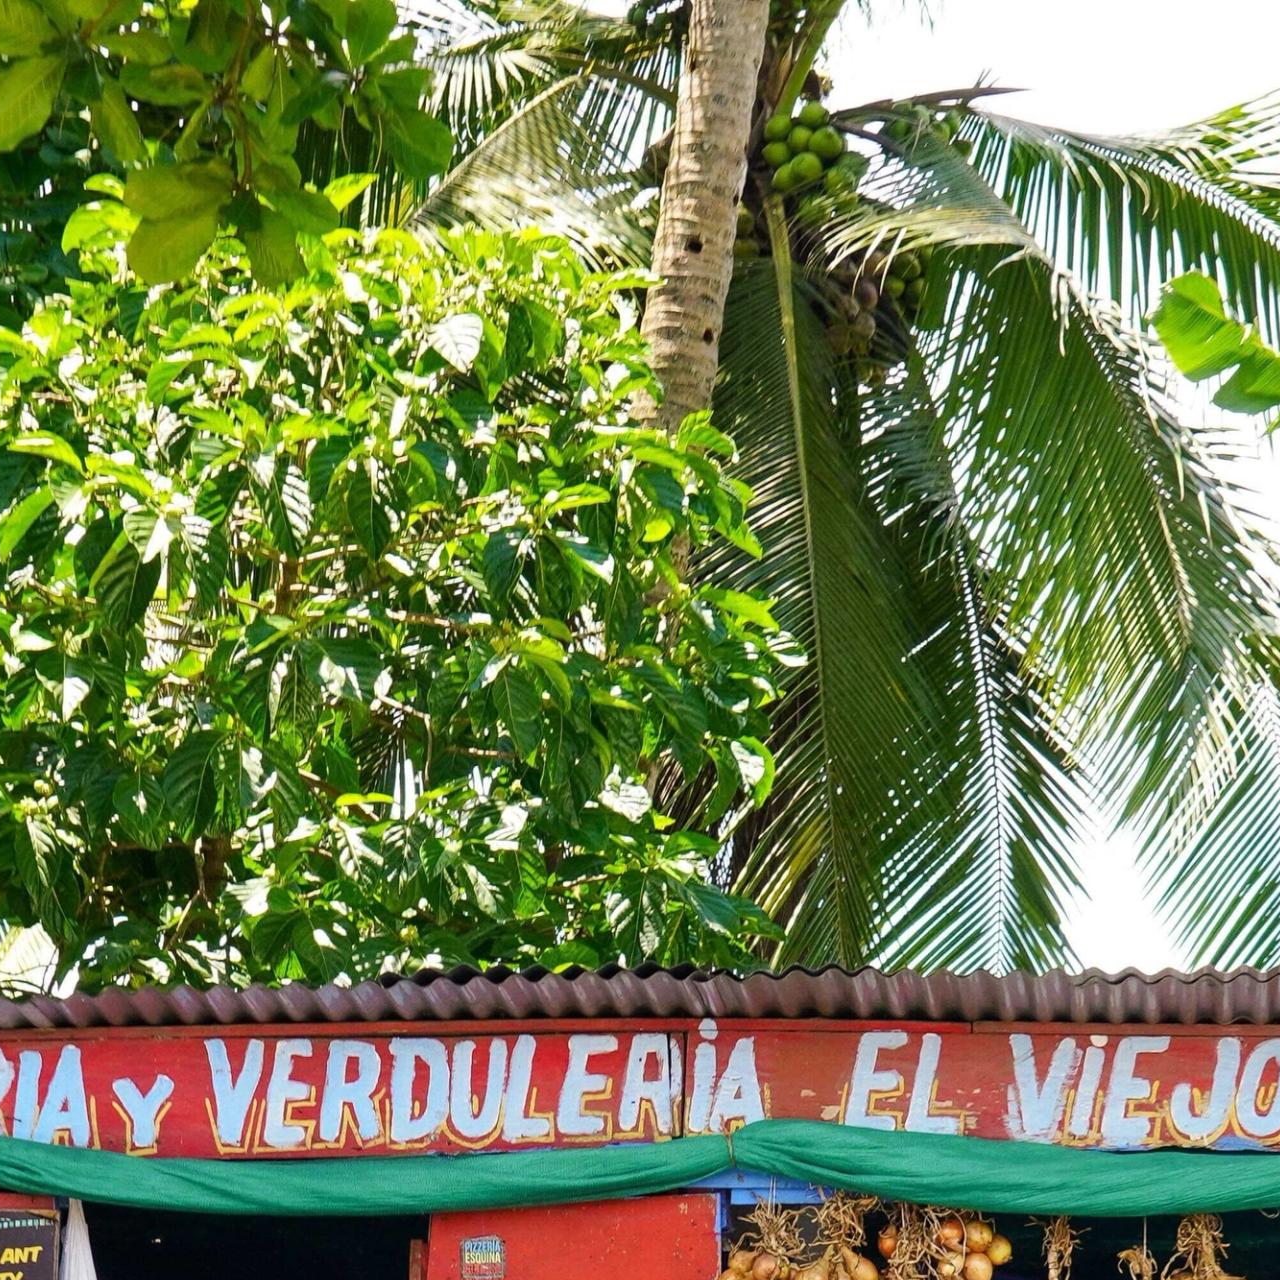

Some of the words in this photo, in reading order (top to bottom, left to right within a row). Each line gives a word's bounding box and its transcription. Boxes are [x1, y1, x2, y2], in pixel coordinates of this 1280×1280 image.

[112, 1073, 175, 1147] Y
[843, 1031, 957, 1135] EL
[464, 1252, 501, 1264] ESQUINA
